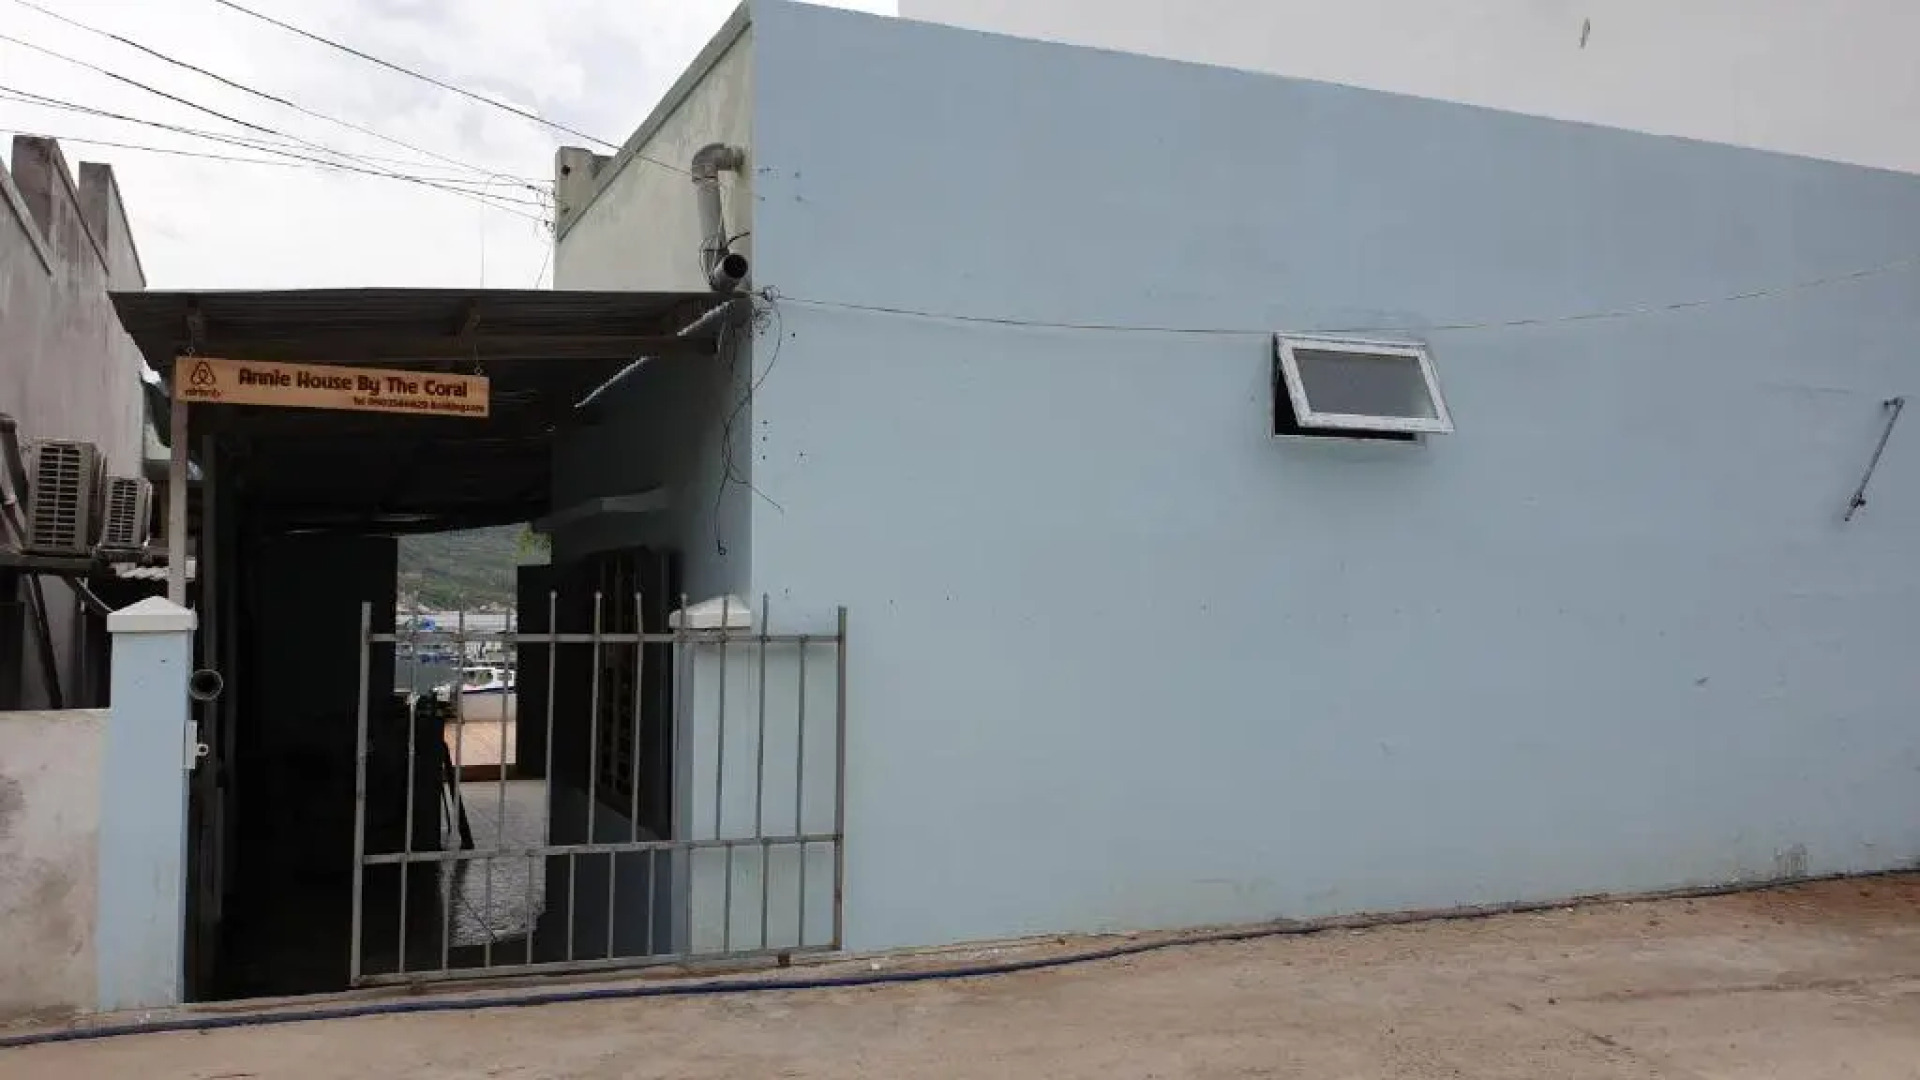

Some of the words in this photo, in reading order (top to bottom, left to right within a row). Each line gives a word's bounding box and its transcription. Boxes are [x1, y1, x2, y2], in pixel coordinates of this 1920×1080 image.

[239, 368, 291, 387] Annie
[297, 371, 352, 390] House
[358, 375, 380, 396] By
[387, 376, 418, 394] The
[424, 380, 468, 397] Coral
